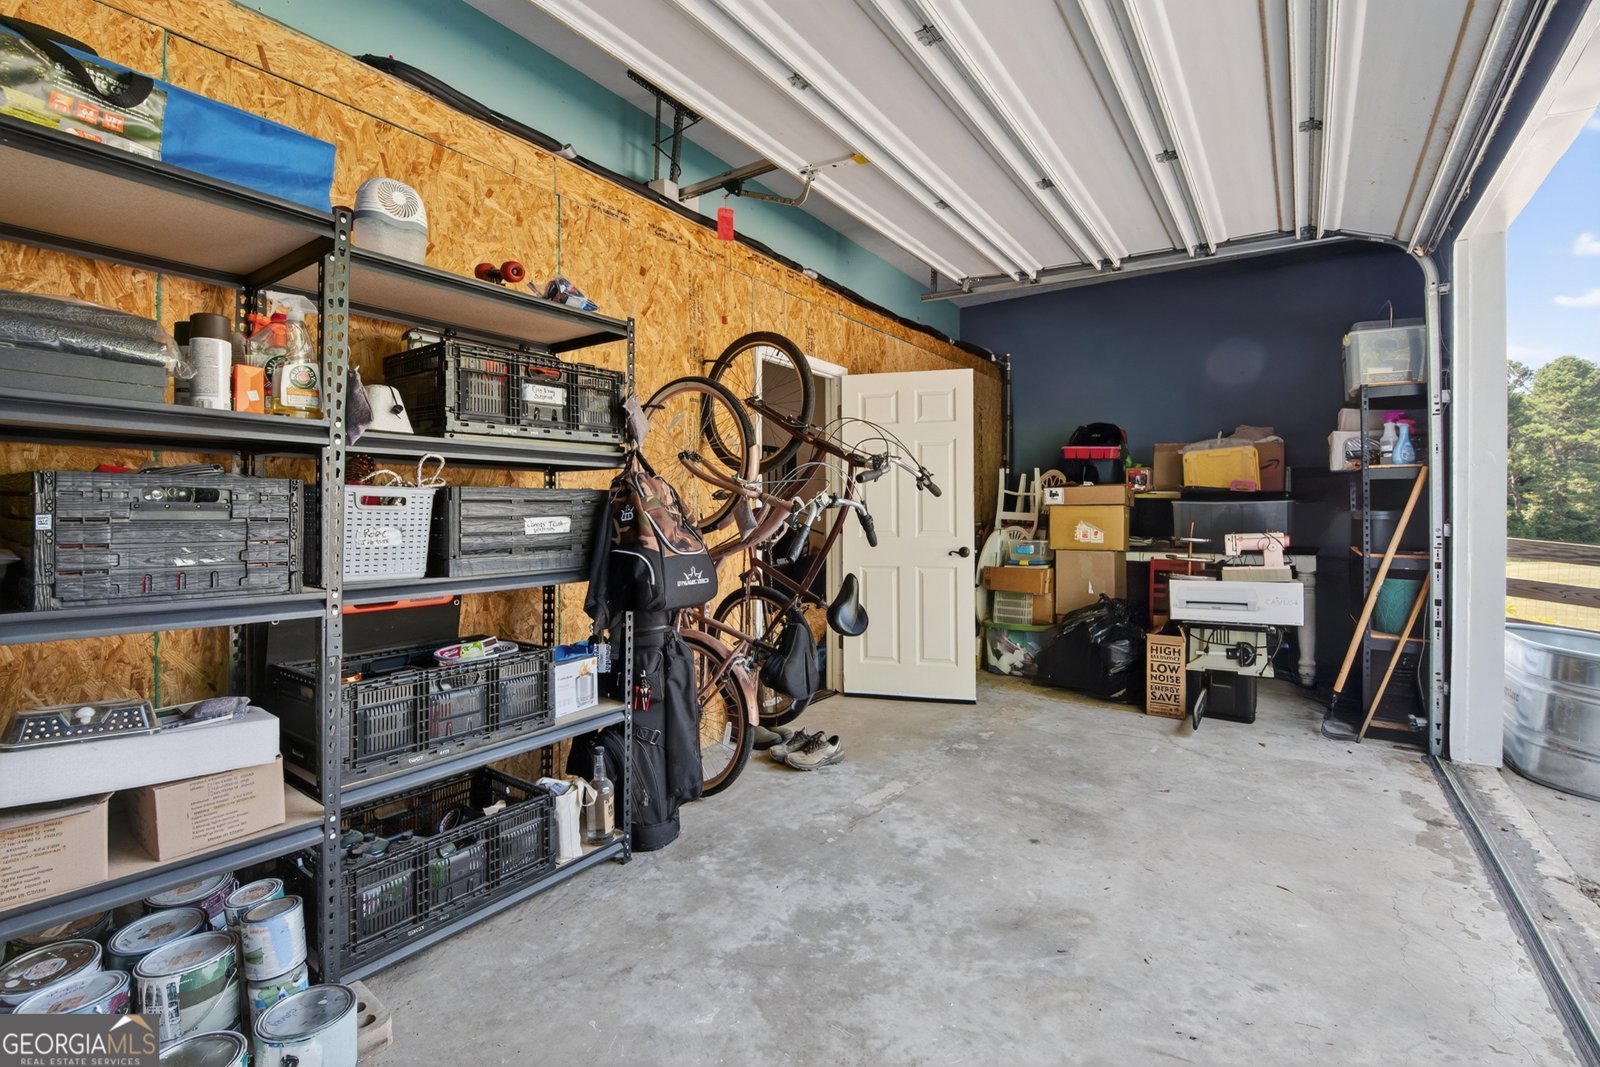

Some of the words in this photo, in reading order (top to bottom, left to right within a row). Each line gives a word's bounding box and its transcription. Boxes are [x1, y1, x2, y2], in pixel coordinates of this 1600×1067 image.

[1150, 645, 1181, 657] HIGH
[1150, 662, 1181, 674] LOW
[1150, 674, 1181, 684] NOISE
[1150, 691, 1181, 704] SAVE
